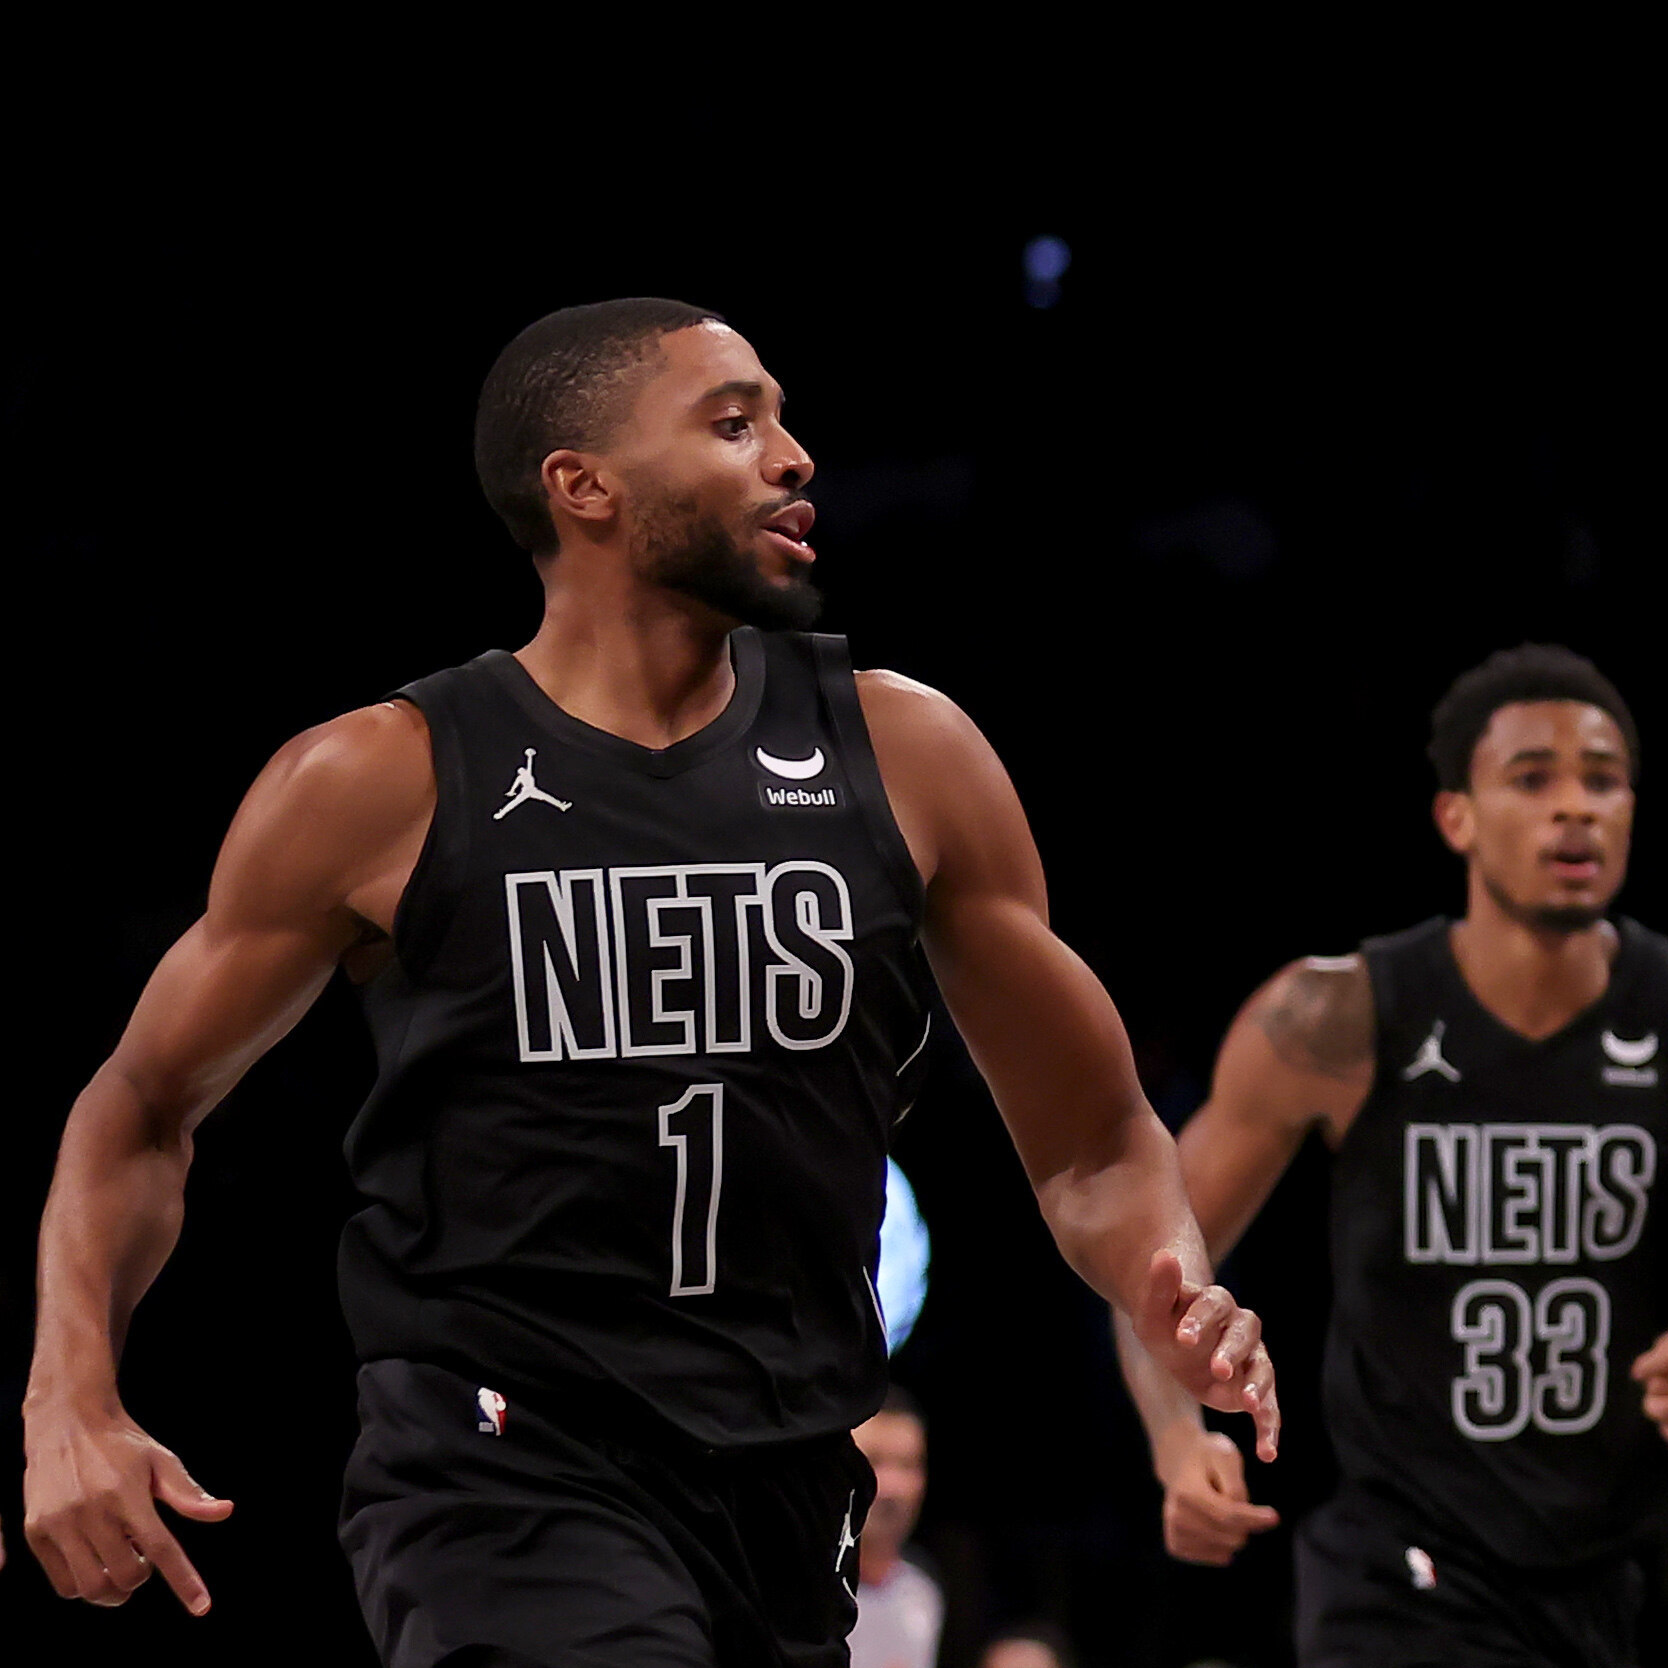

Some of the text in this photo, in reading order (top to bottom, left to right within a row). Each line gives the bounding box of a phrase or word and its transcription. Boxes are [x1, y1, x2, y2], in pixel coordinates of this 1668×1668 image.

[766, 787, 836, 806] Webull
[505, 861, 854, 1062] NETS
[659, 1083, 724, 1297] 1
[1404, 1123, 1656, 1265] NETS
[1451, 1276, 1611, 1441] 33
